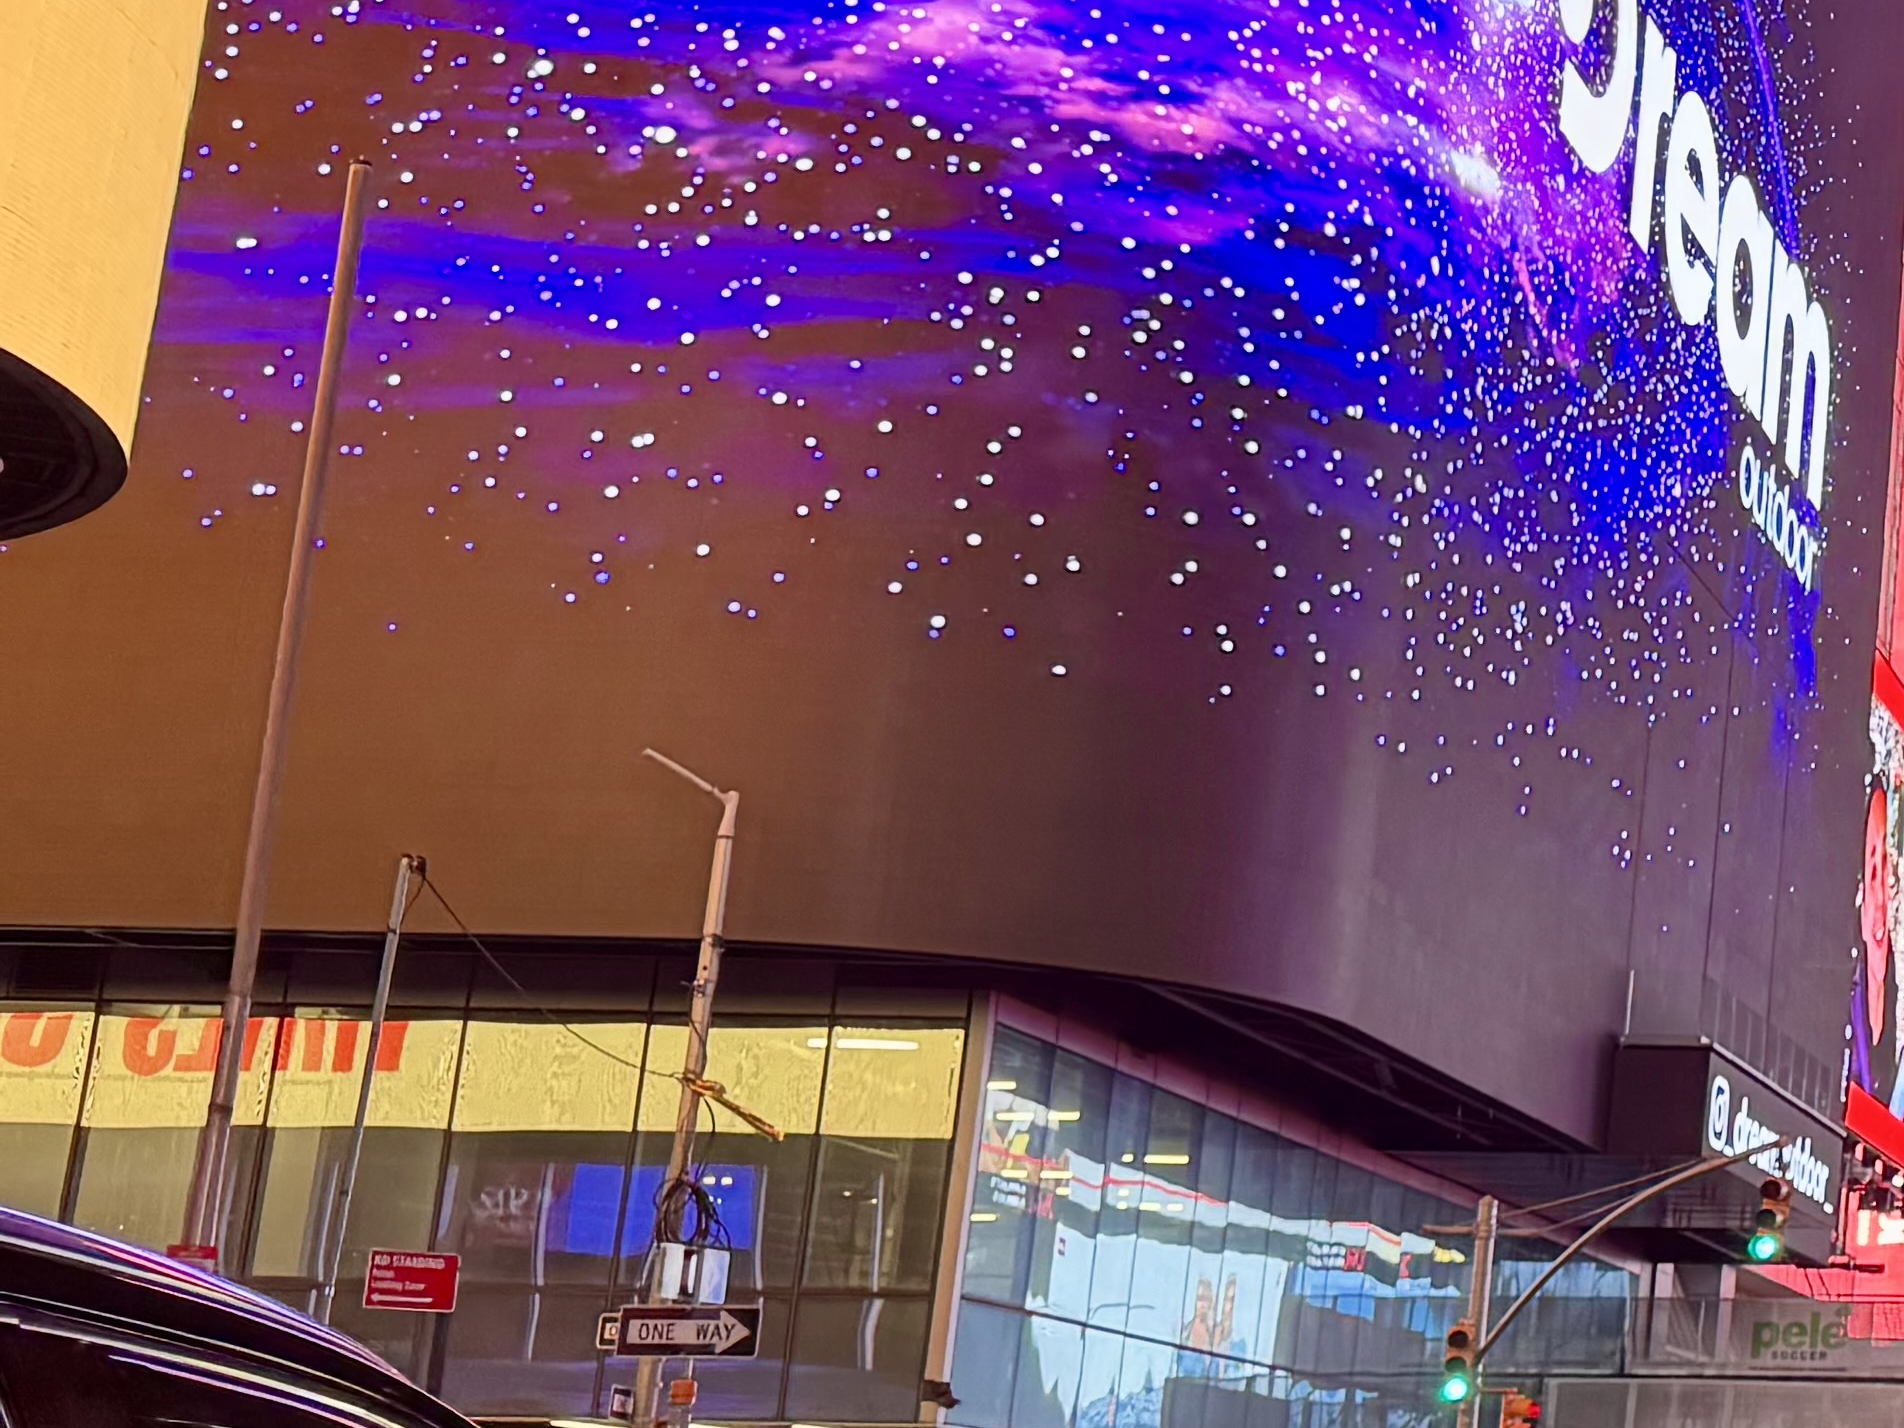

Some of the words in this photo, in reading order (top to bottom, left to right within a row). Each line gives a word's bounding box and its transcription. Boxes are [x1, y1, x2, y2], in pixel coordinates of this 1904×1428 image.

[1738, 440, 1820, 594] outdoor
[637, 1322, 676, 1341] ONE
[695, 1322, 737, 1341] WAY
